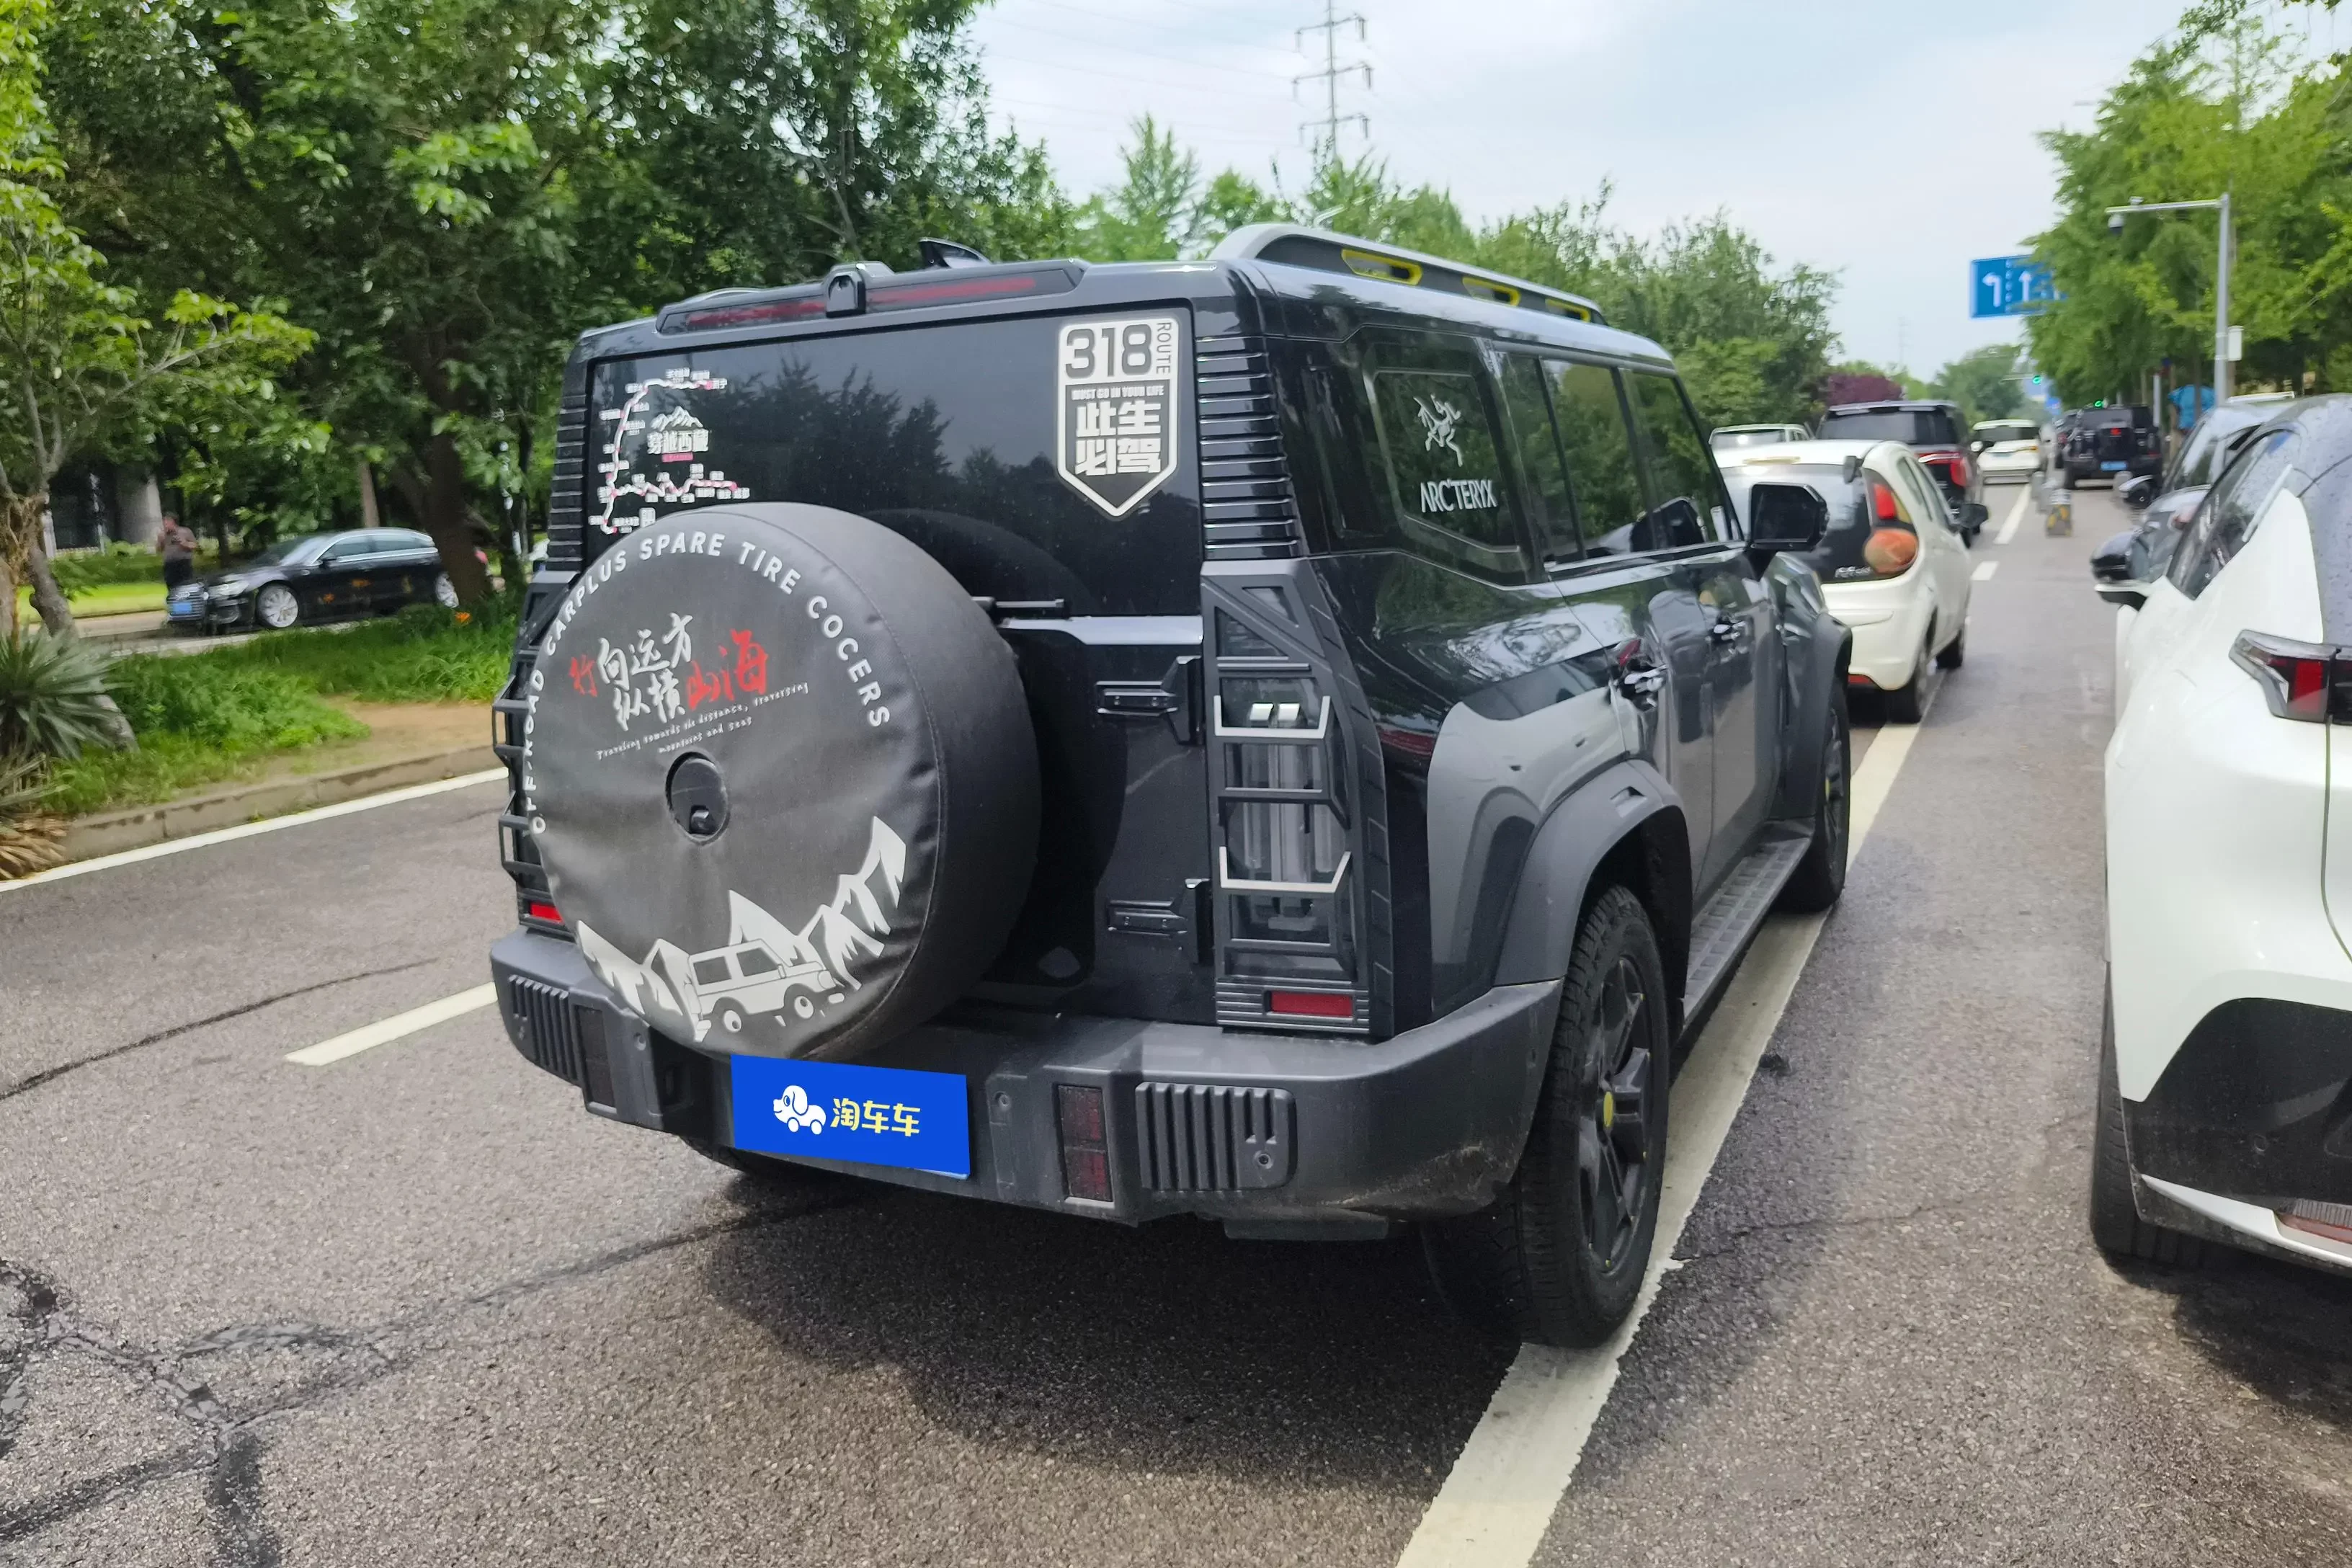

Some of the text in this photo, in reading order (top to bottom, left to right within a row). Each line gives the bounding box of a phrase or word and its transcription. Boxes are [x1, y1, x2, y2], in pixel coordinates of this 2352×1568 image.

[1065, 322, 1172, 379] 318 ROUTE
[1076, 399, 1161, 437] 此生
[1075, 437, 1161, 476] 必驾
[545, 550, 627, 656] CARPLUS
[638, 530, 726, 561] SPARE
[739, 541, 801, 594] TIRE
[808, 595, 890, 727] COCERS
